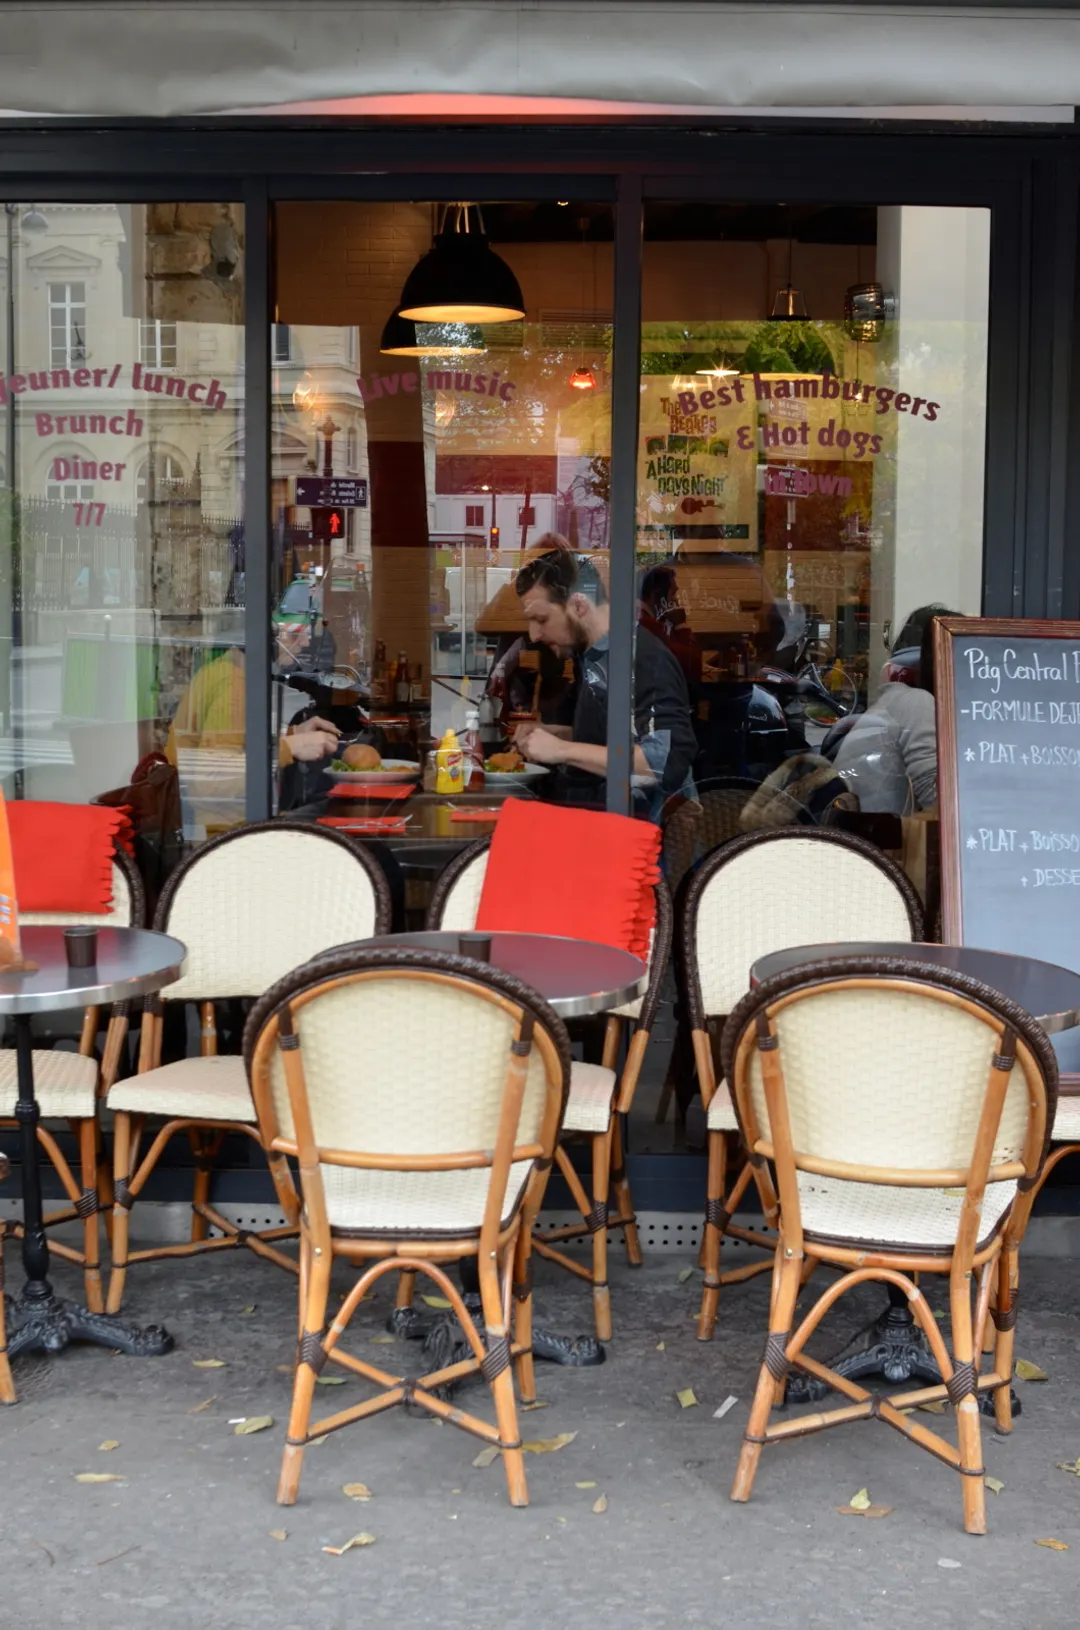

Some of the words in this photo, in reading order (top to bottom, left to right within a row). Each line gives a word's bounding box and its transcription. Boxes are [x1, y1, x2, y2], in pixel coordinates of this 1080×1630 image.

[132, 362, 227, 410] lunch
[356, 372, 419, 401] Live
[426, 371, 516, 401] music
[678, 378, 745, 416] Best
[753, 368, 941, 421] hamburgers
[35, 408, 144, 437] Brunch
[763, 420, 811, 449] Hot
[818, 418, 883, 459] dogs
[53, 454, 126, 482] Diner
[73, 502, 106, 527] 7/7
[1003, 648, 1068, 681] Central
